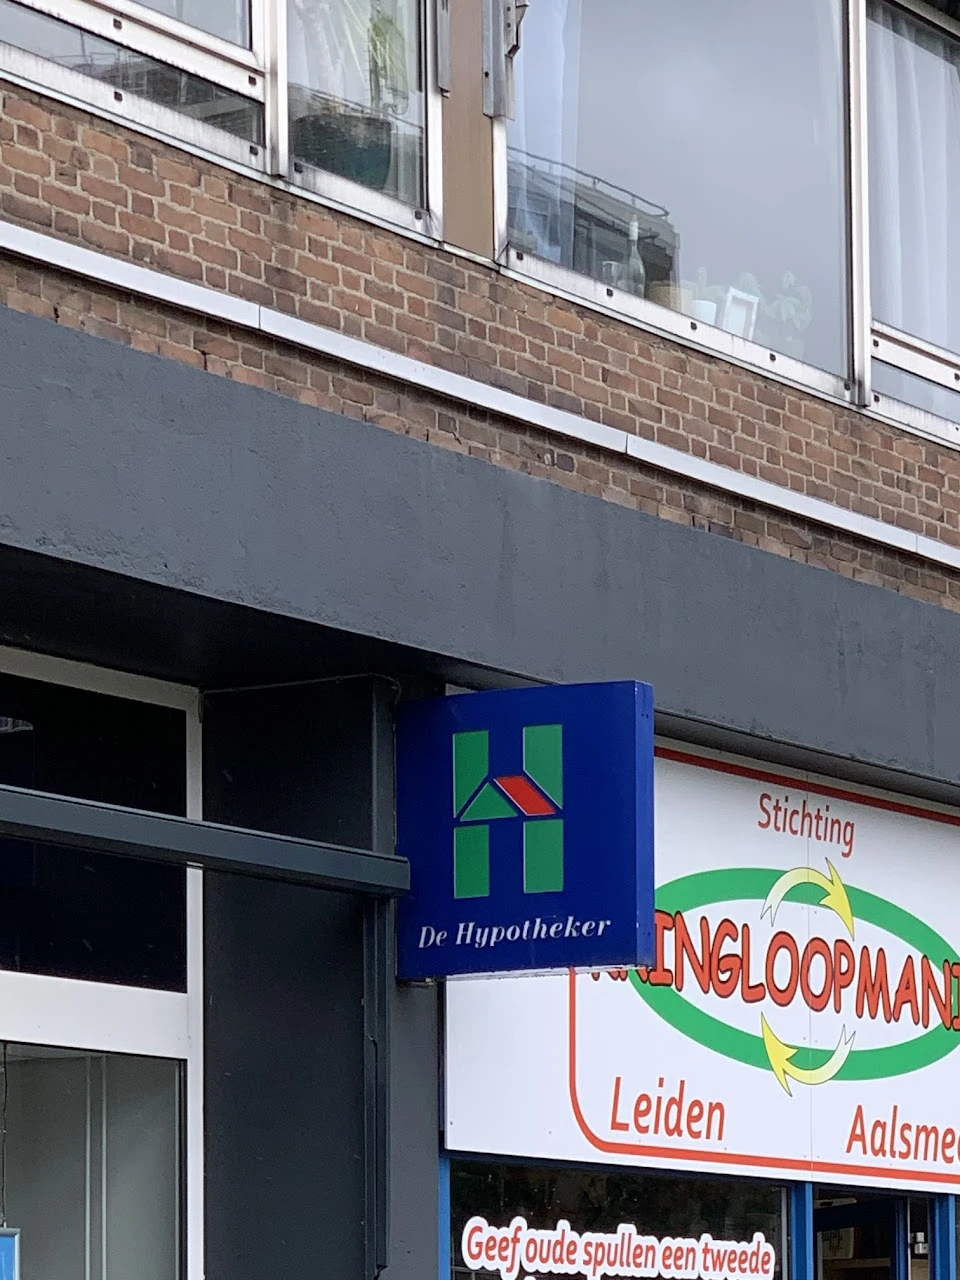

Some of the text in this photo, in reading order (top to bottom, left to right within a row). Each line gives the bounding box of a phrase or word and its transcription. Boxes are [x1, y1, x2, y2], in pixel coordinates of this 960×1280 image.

[758, 793, 855, 858] Stichting
[418, 915, 611, 949] De Hypotheker
[610, 1076, 725, 1141] Leiden
[467, 1225, 772, 1276] Geef oude spullen een tweede
